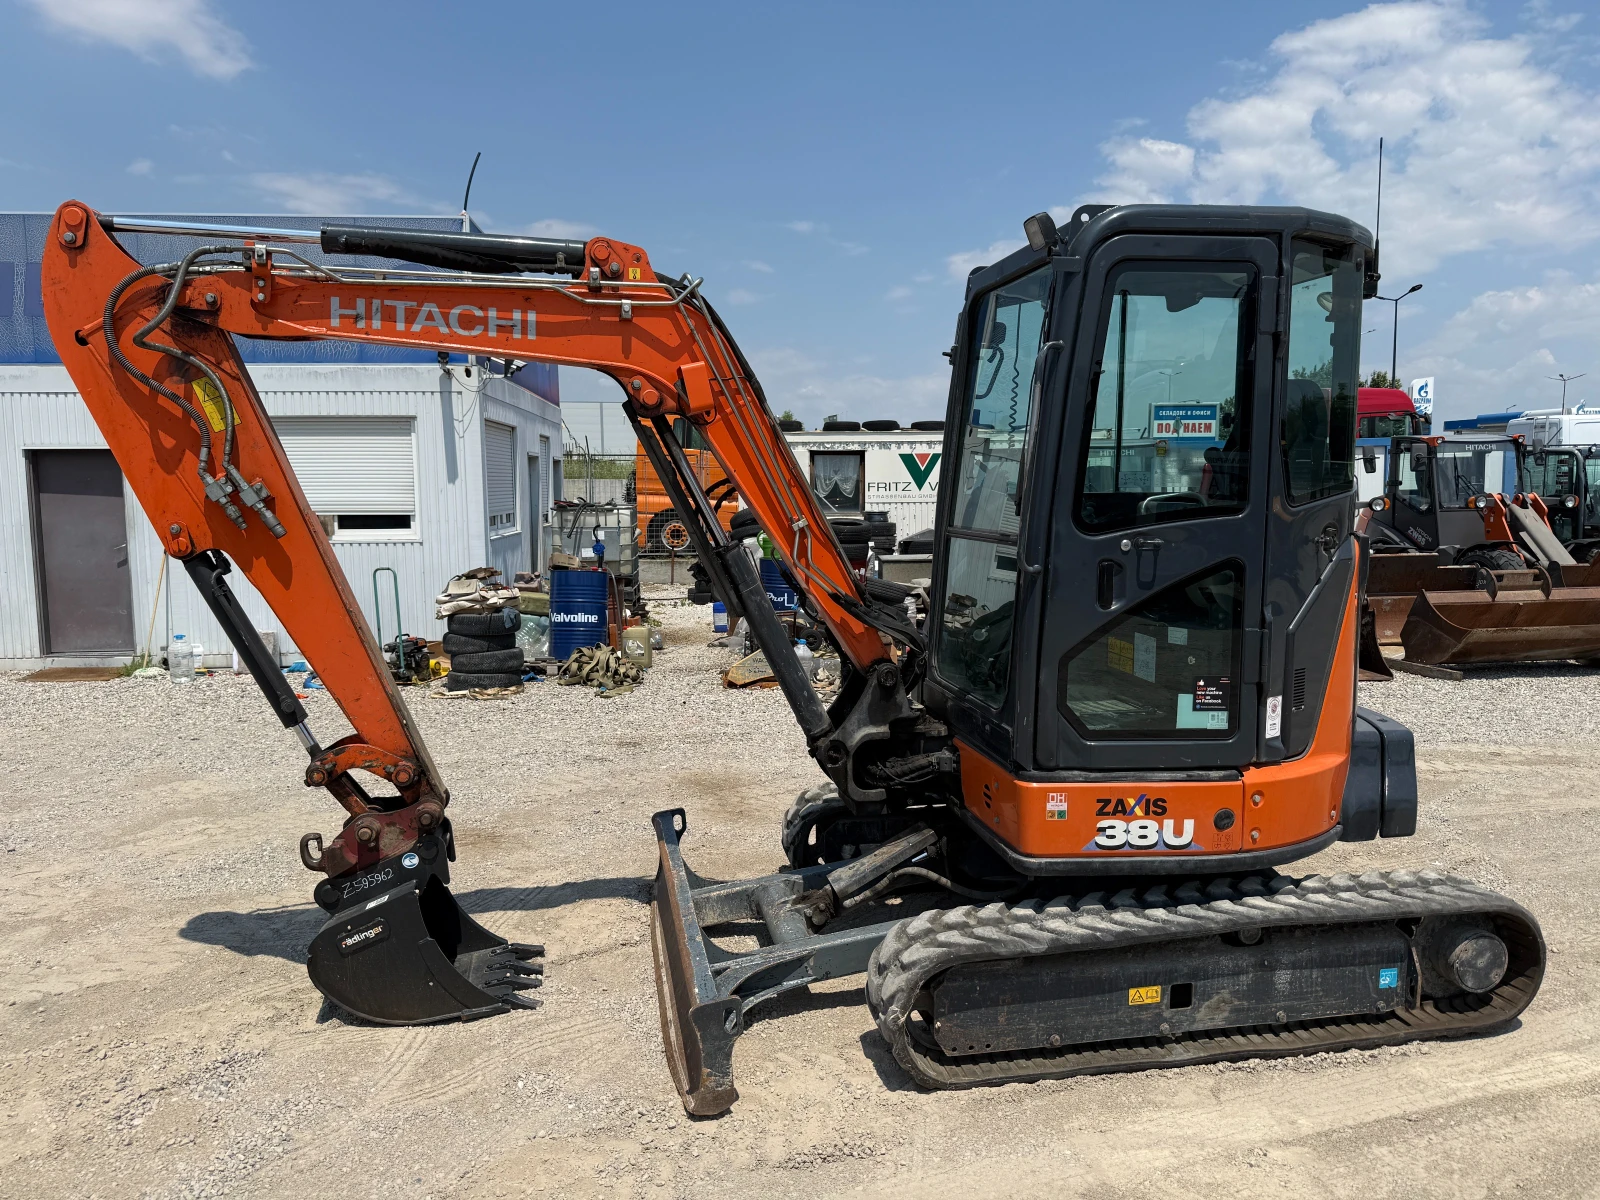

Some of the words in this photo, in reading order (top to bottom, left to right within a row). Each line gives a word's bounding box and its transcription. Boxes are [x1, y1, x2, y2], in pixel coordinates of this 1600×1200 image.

[330, 296, 537, 341] HITACHI
[1183, 422, 1212, 433] НАЕМ
[867, 481, 912, 492] FRITZ
[550, 612, 599, 623] Valvoline
[1095, 794, 1168, 817] ZAXIS
[1094, 818, 1195, 851] 38U
[341, 867, 395, 899] Z595962
[341, 924, 383, 949] rädlinger
